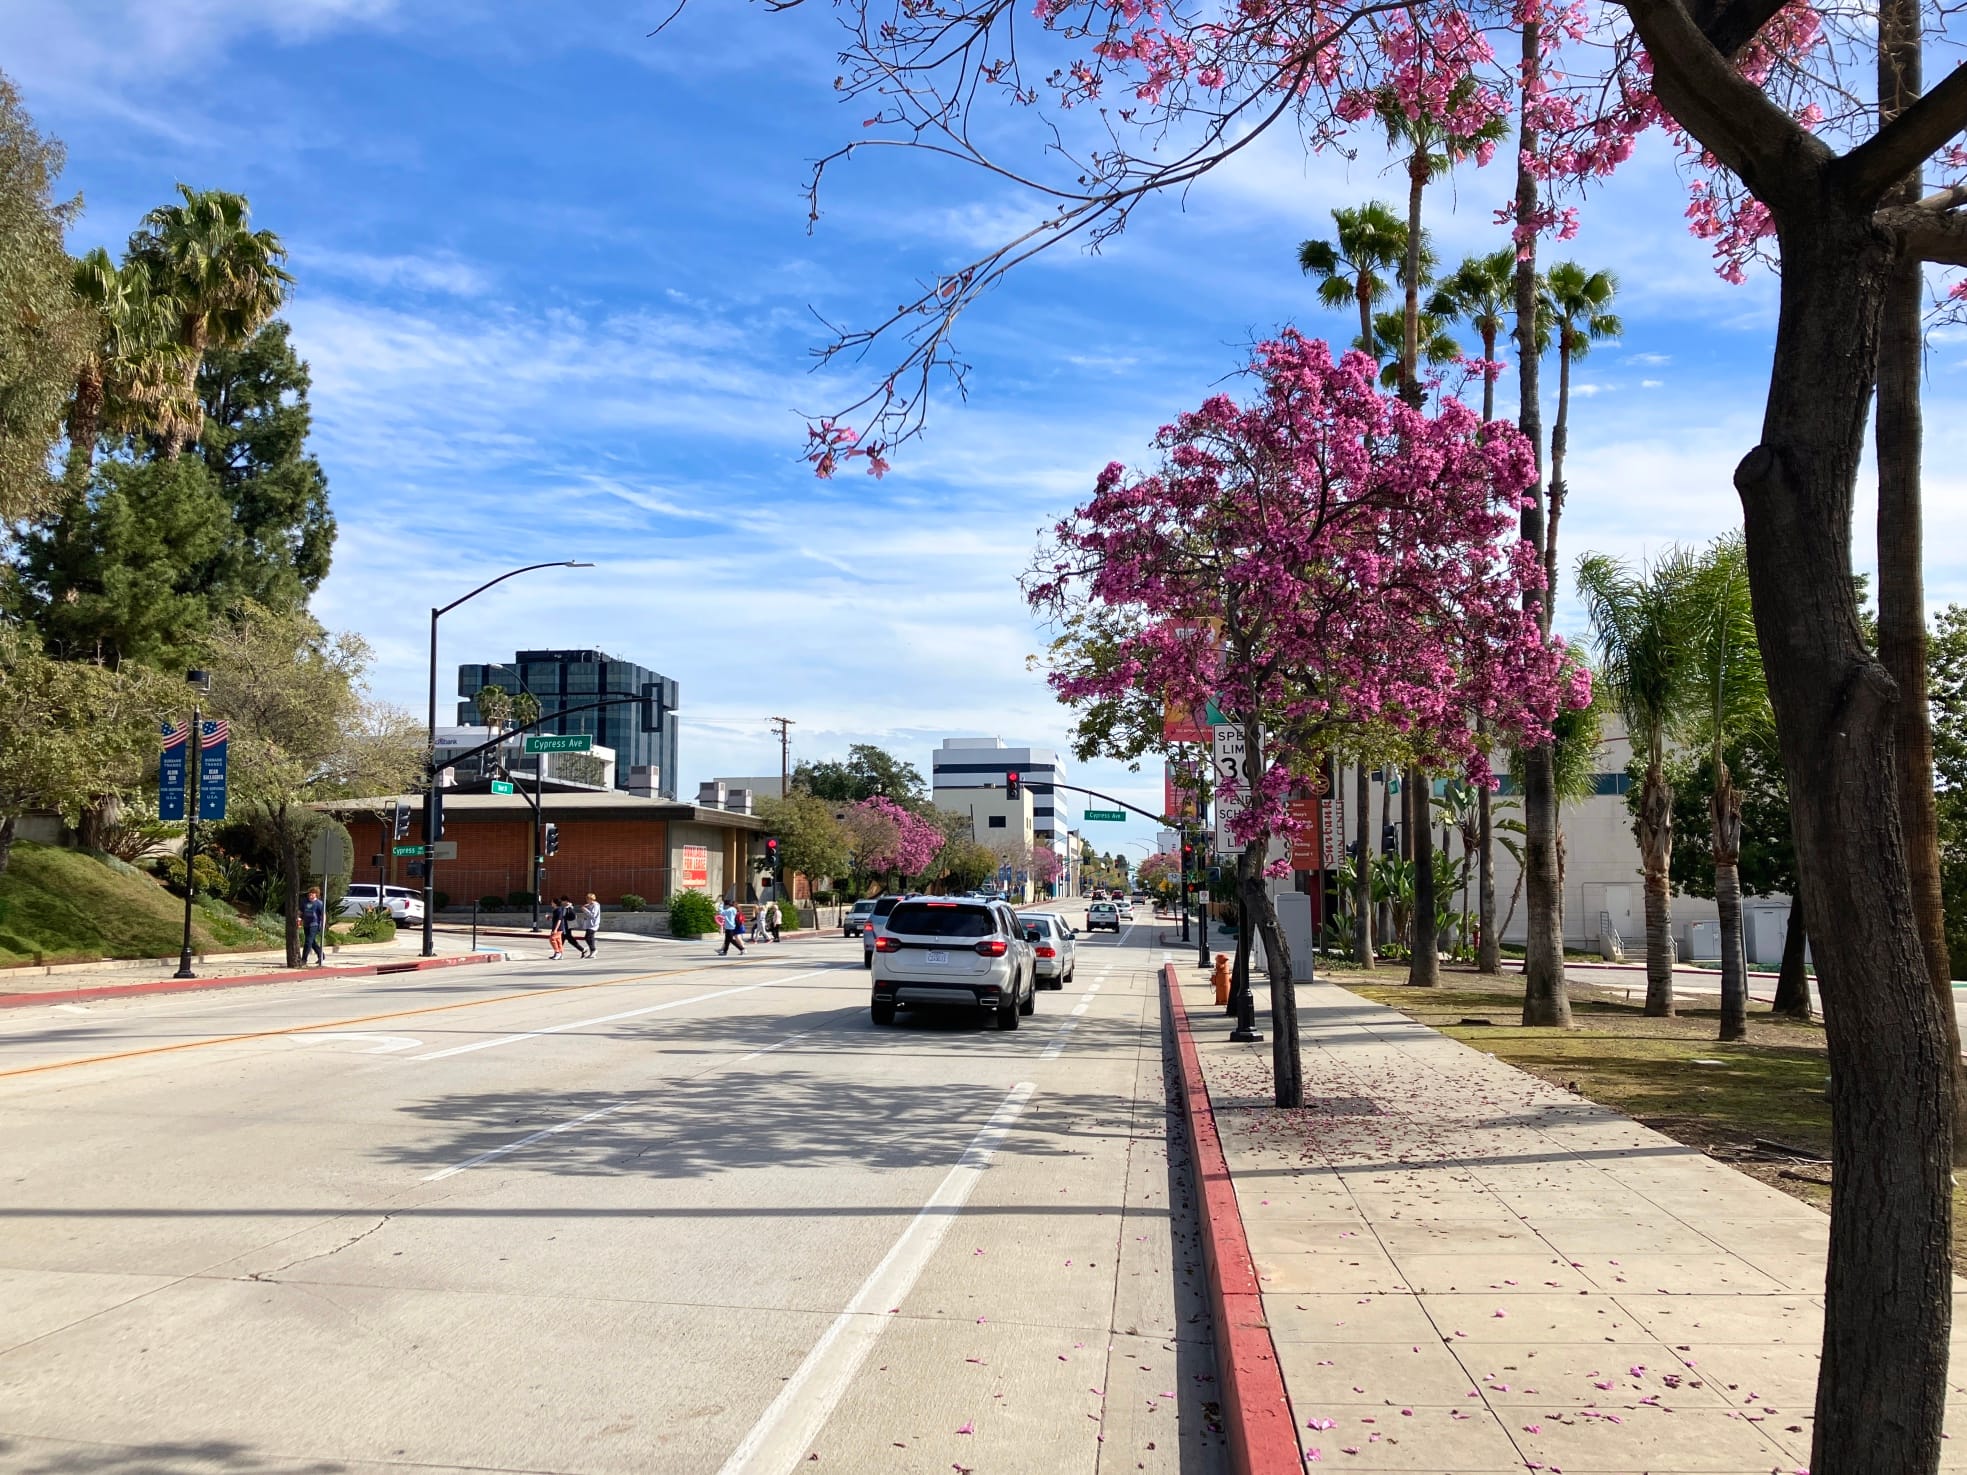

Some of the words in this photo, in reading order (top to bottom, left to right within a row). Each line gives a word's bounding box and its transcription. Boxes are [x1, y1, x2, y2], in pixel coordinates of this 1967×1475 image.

[534, 738, 566, 749] Cypress
[569, 738, 583, 748] Ave
[1090, 812, 1111, 820] Cypress
[1336, 799, 1345, 836] CENTER
[1322, 800, 1336, 870] Burbank
[392, 846, 416, 856] Cypress
